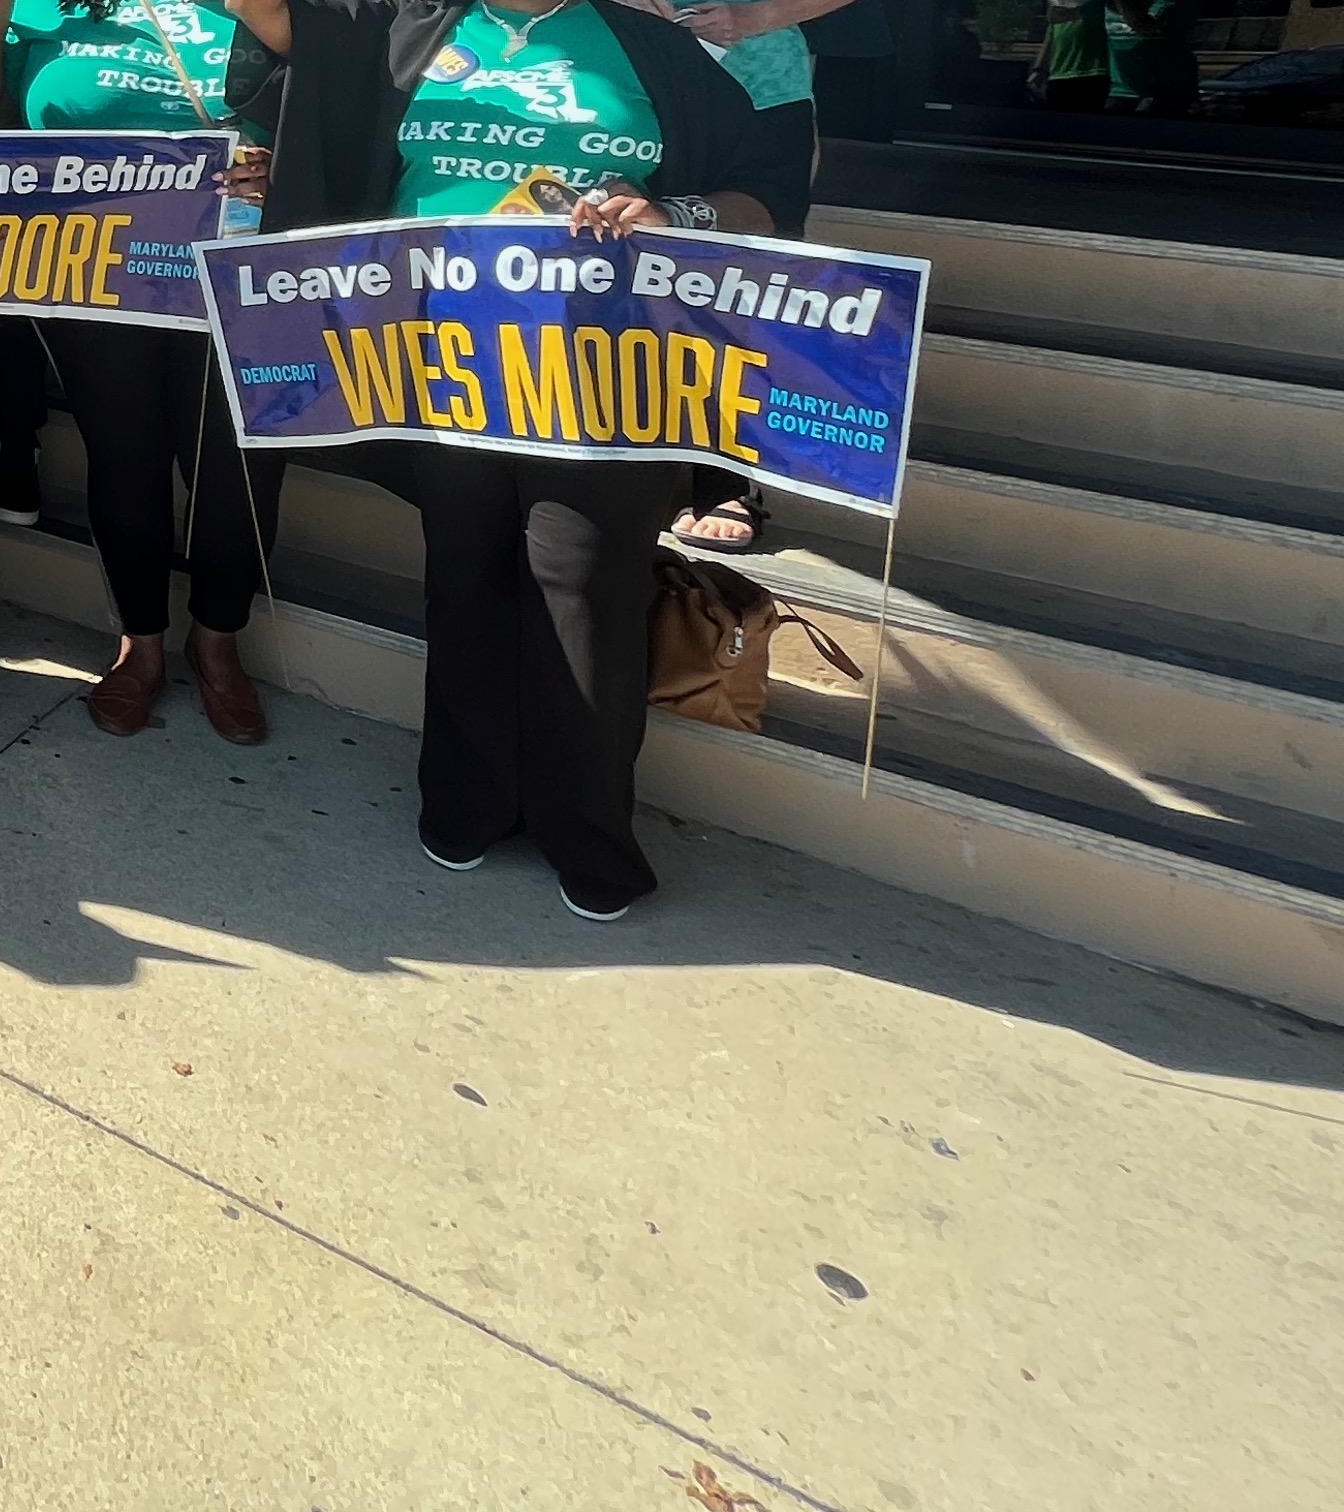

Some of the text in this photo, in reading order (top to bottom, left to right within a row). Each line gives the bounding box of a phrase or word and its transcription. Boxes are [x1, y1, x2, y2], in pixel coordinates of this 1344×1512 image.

[170, 15, 193, 36] 3
[96, 69, 226, 99] TROUBL
[536, 86, 566, 107] 3
[397, 121, 546, 148] AKING
[51, 154, 208, 194] Behind
[129, 241, 194, 259] MARYLAN
[237, 245, 882, 337] Leave No One Behind
[240, 361, 317, 386] DEMOCRAT
[322, 319, 770, 465] WES MOORE
[769, 385, 890, 431] MARYLAND
[766, 410, 887, 455] GOVERNOR
